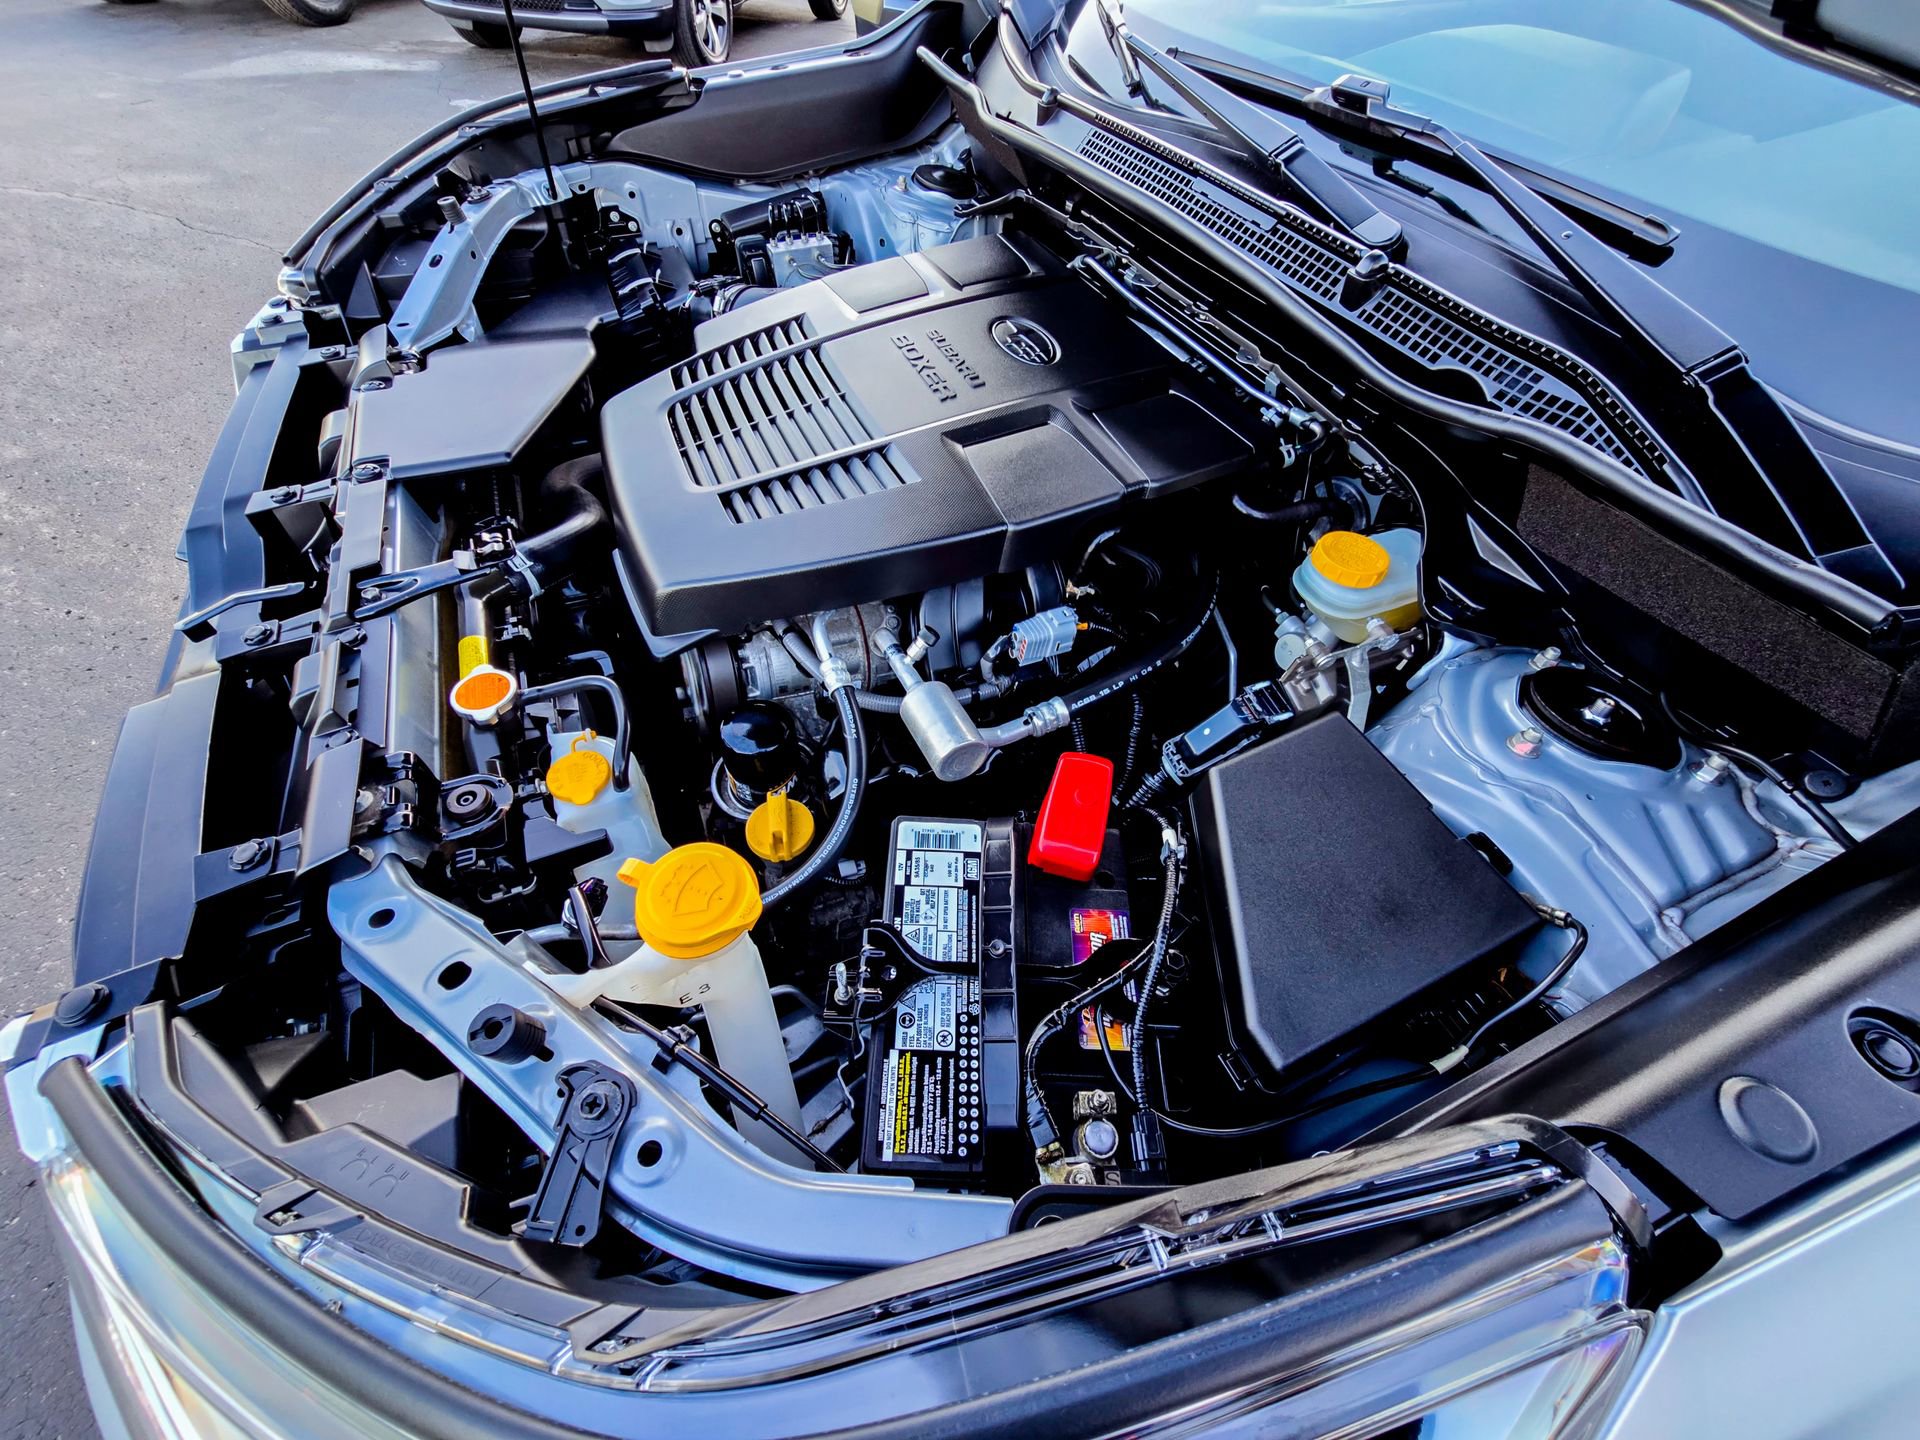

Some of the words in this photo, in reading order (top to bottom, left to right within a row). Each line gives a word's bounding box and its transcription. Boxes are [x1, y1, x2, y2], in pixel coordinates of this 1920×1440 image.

[890, 334, 958, 403] BOXER
[926, 329, 986, 389] SUBARU
[1113, 681, 1125, 691] LP
[966, 860, 977, 878] AGM
[878, 1109, 886, 1141] IMPORTANT
[886, 1141, 891, 1150] DO
